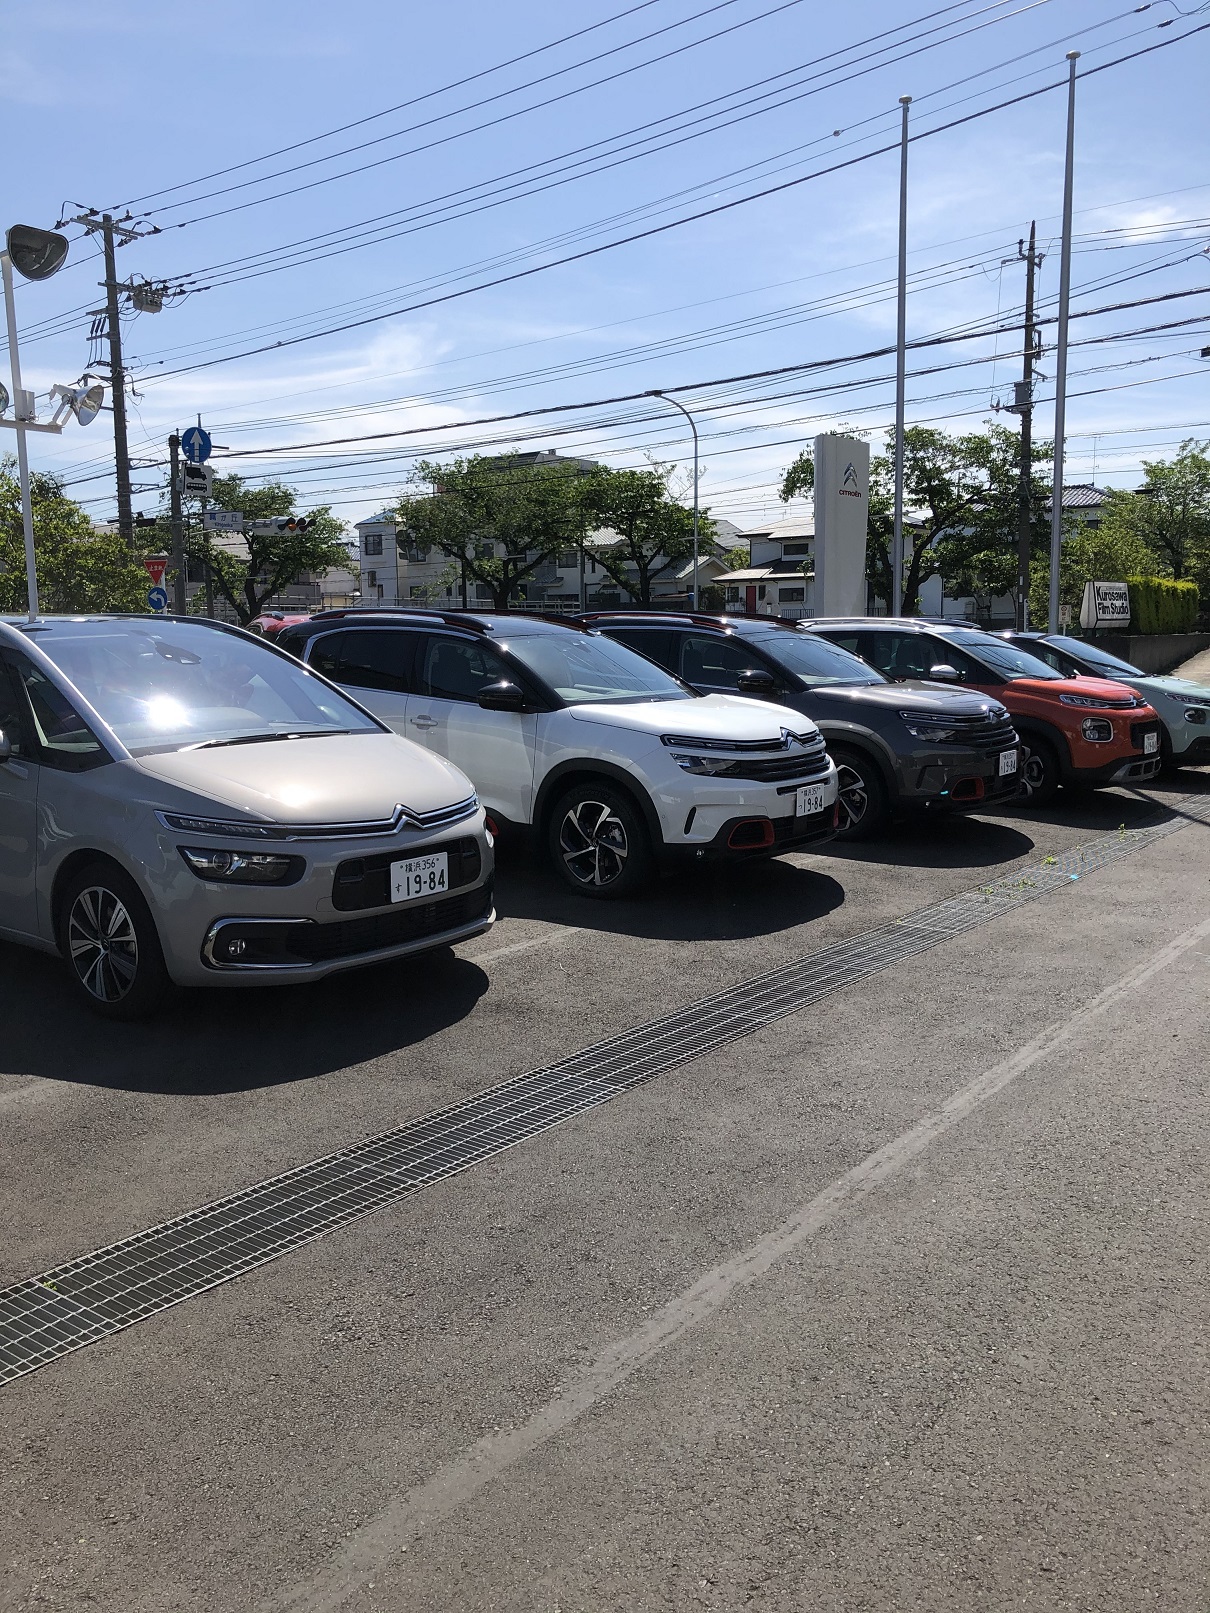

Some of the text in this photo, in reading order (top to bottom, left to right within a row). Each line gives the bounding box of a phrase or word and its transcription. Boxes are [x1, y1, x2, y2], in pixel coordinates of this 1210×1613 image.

[1095, 586, 1127, 601] Kurosawa
[1098, 602, 1129, 615] Film Studio
[803, 795, 823, 813] 19-84
[405, 857, 436, 873] 横浜356
[406, 868, 446, 897] 19-84
